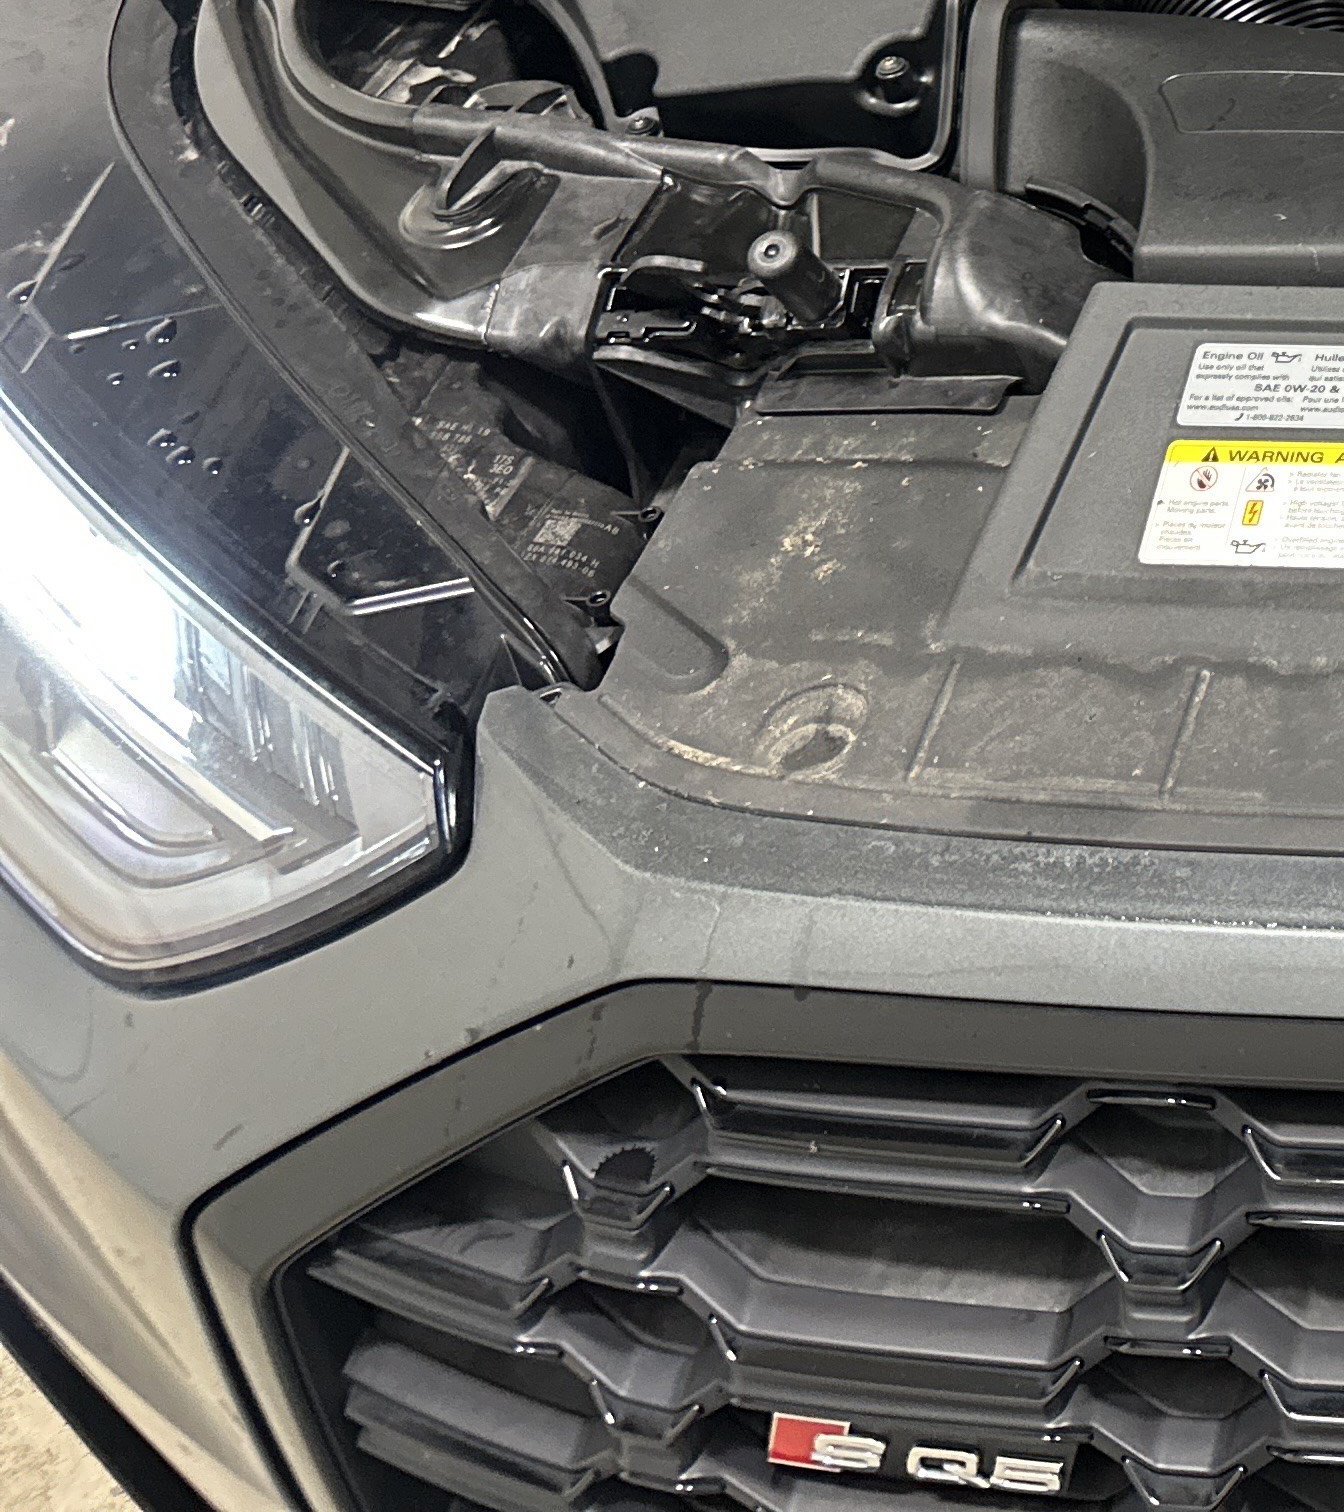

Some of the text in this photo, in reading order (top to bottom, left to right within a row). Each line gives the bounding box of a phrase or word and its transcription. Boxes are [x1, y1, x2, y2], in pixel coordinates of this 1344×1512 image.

[1202, 351, 1264, 362] Engine Oil
[1314, 353, 1344, 362] Huile
[1216, 364, 1234, 372] only
[1254, 384, 1281, 392] SAE
[1284, 384, 1326, 393] 0W-20
[1329, 385, 1340, 393] &
[1229, 450, 1324, 463] WARNING
